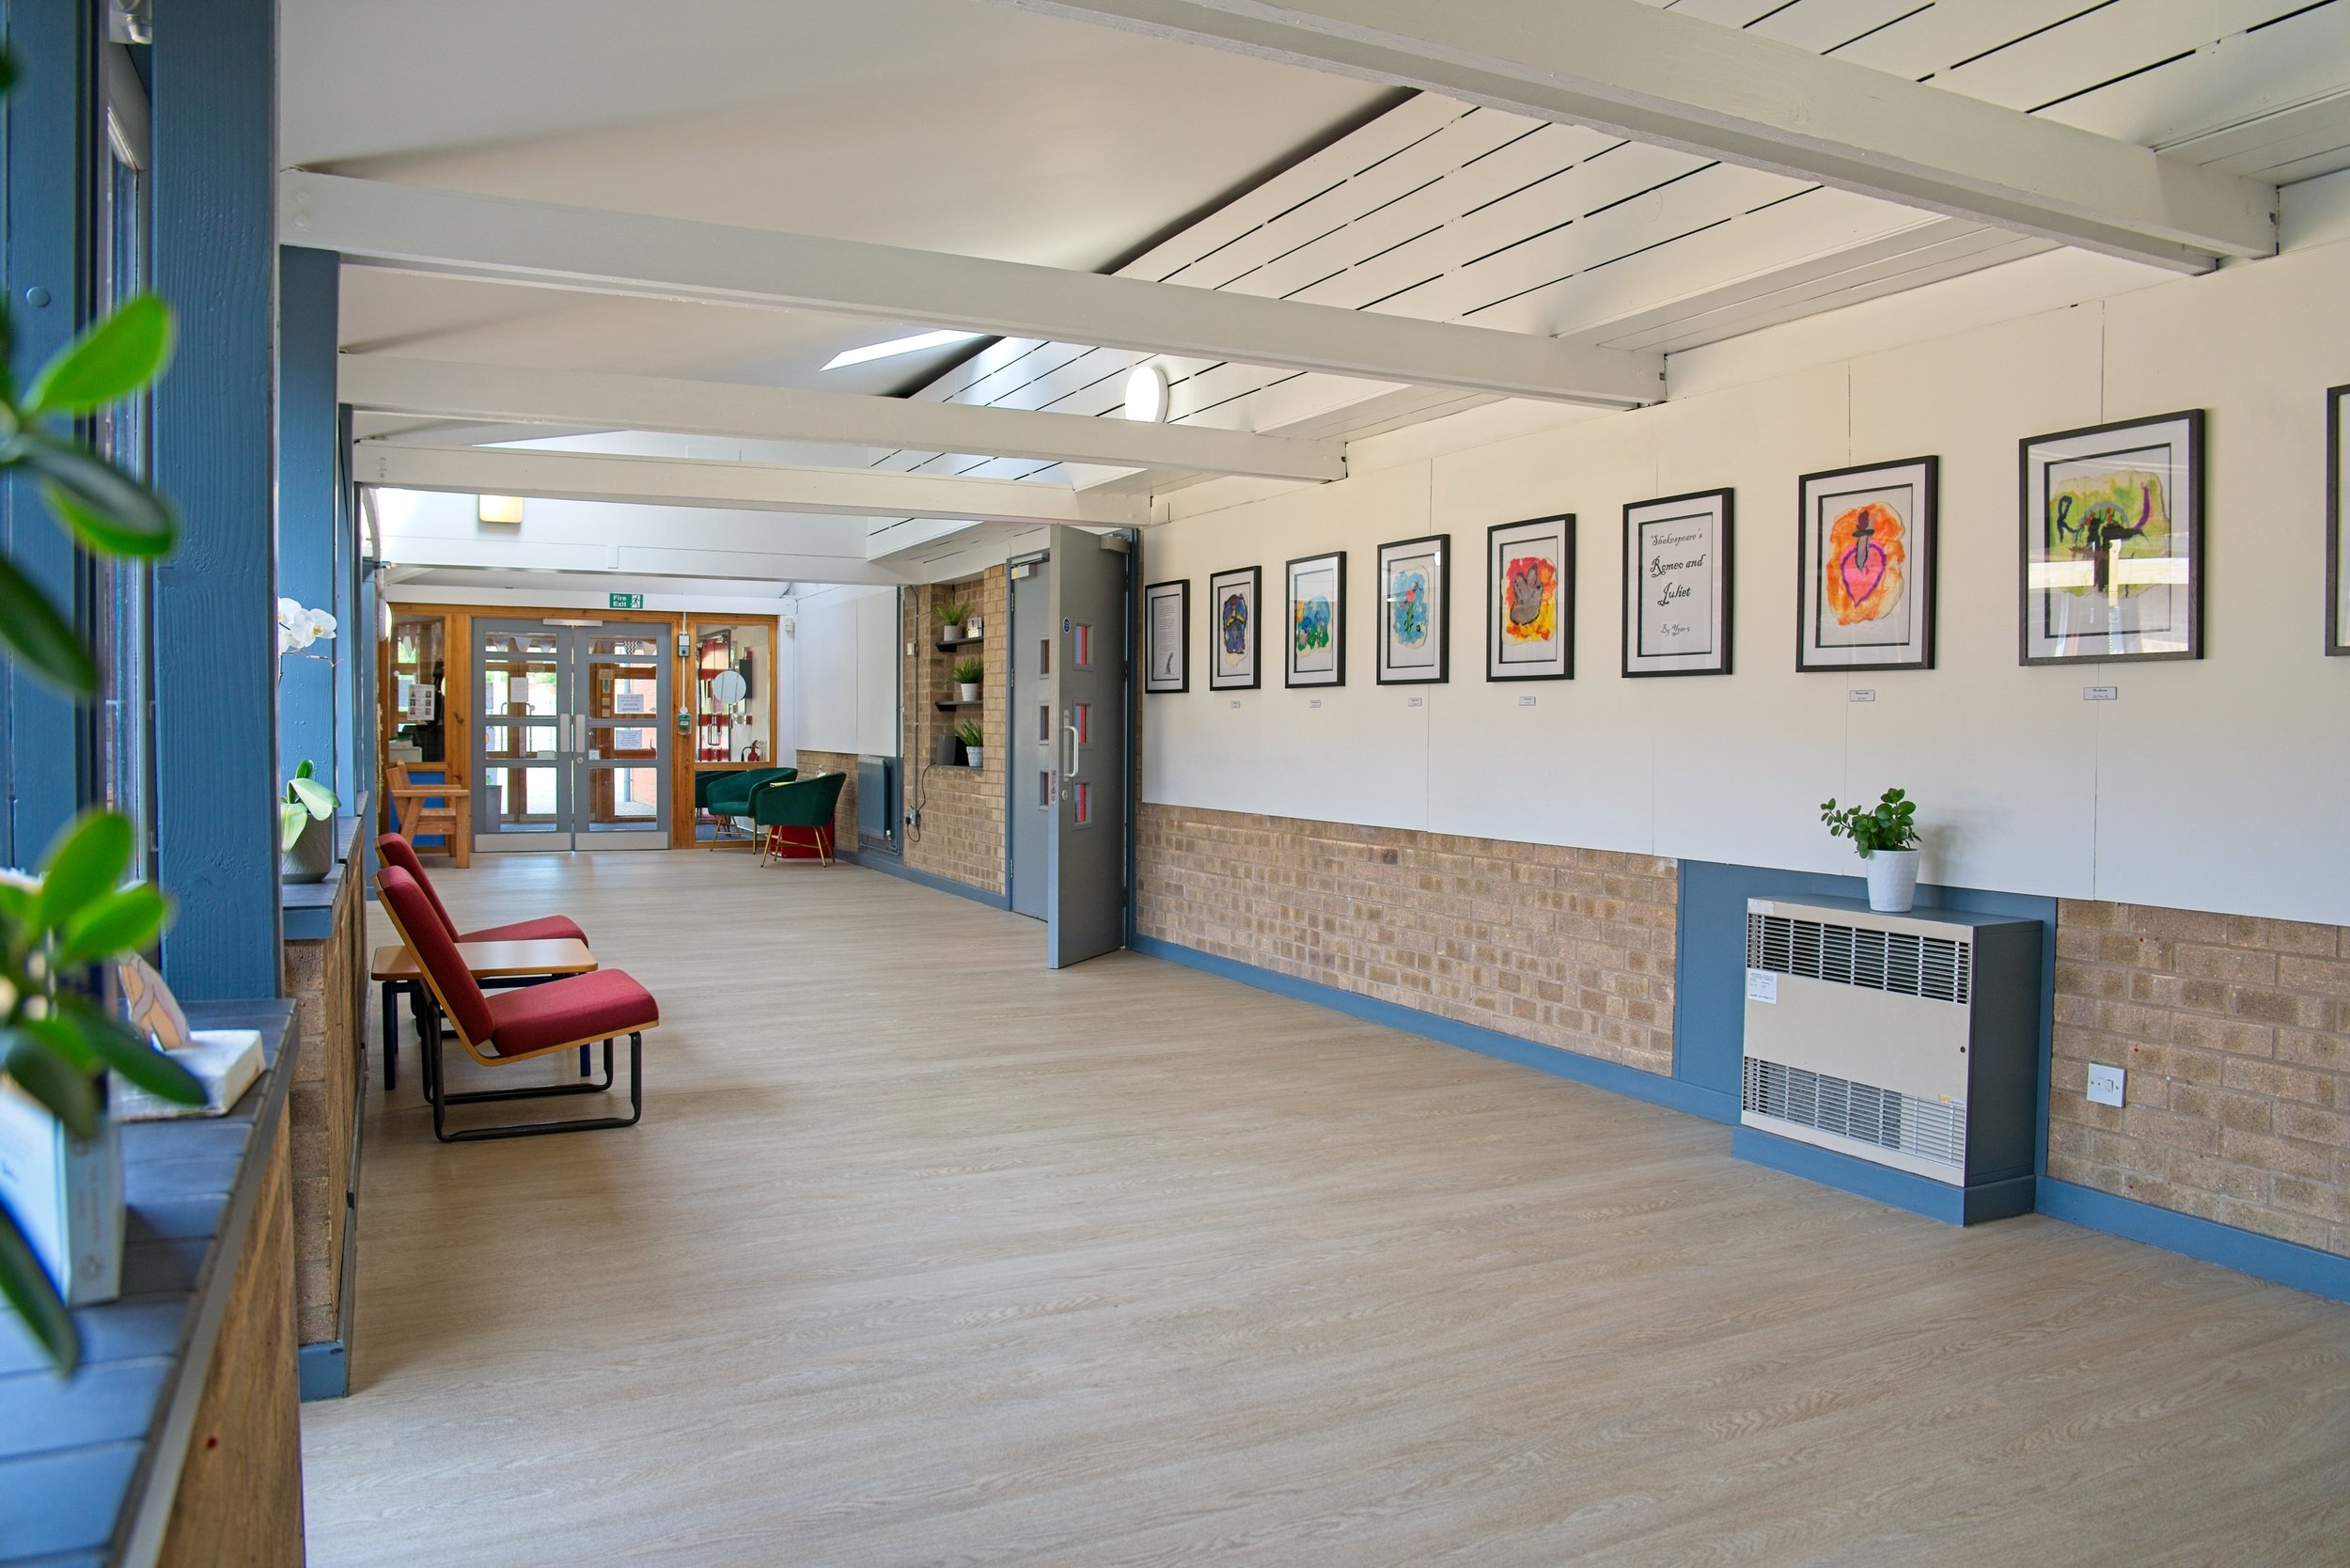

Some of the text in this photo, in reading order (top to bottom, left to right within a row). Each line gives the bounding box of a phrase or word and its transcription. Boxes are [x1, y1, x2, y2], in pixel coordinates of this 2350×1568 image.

[1651, 528, 1702, 546] Shakespeare's
[1650, 554, 1706, 578] Romeo and
[1657, 582, 1691, 606] Juliet
